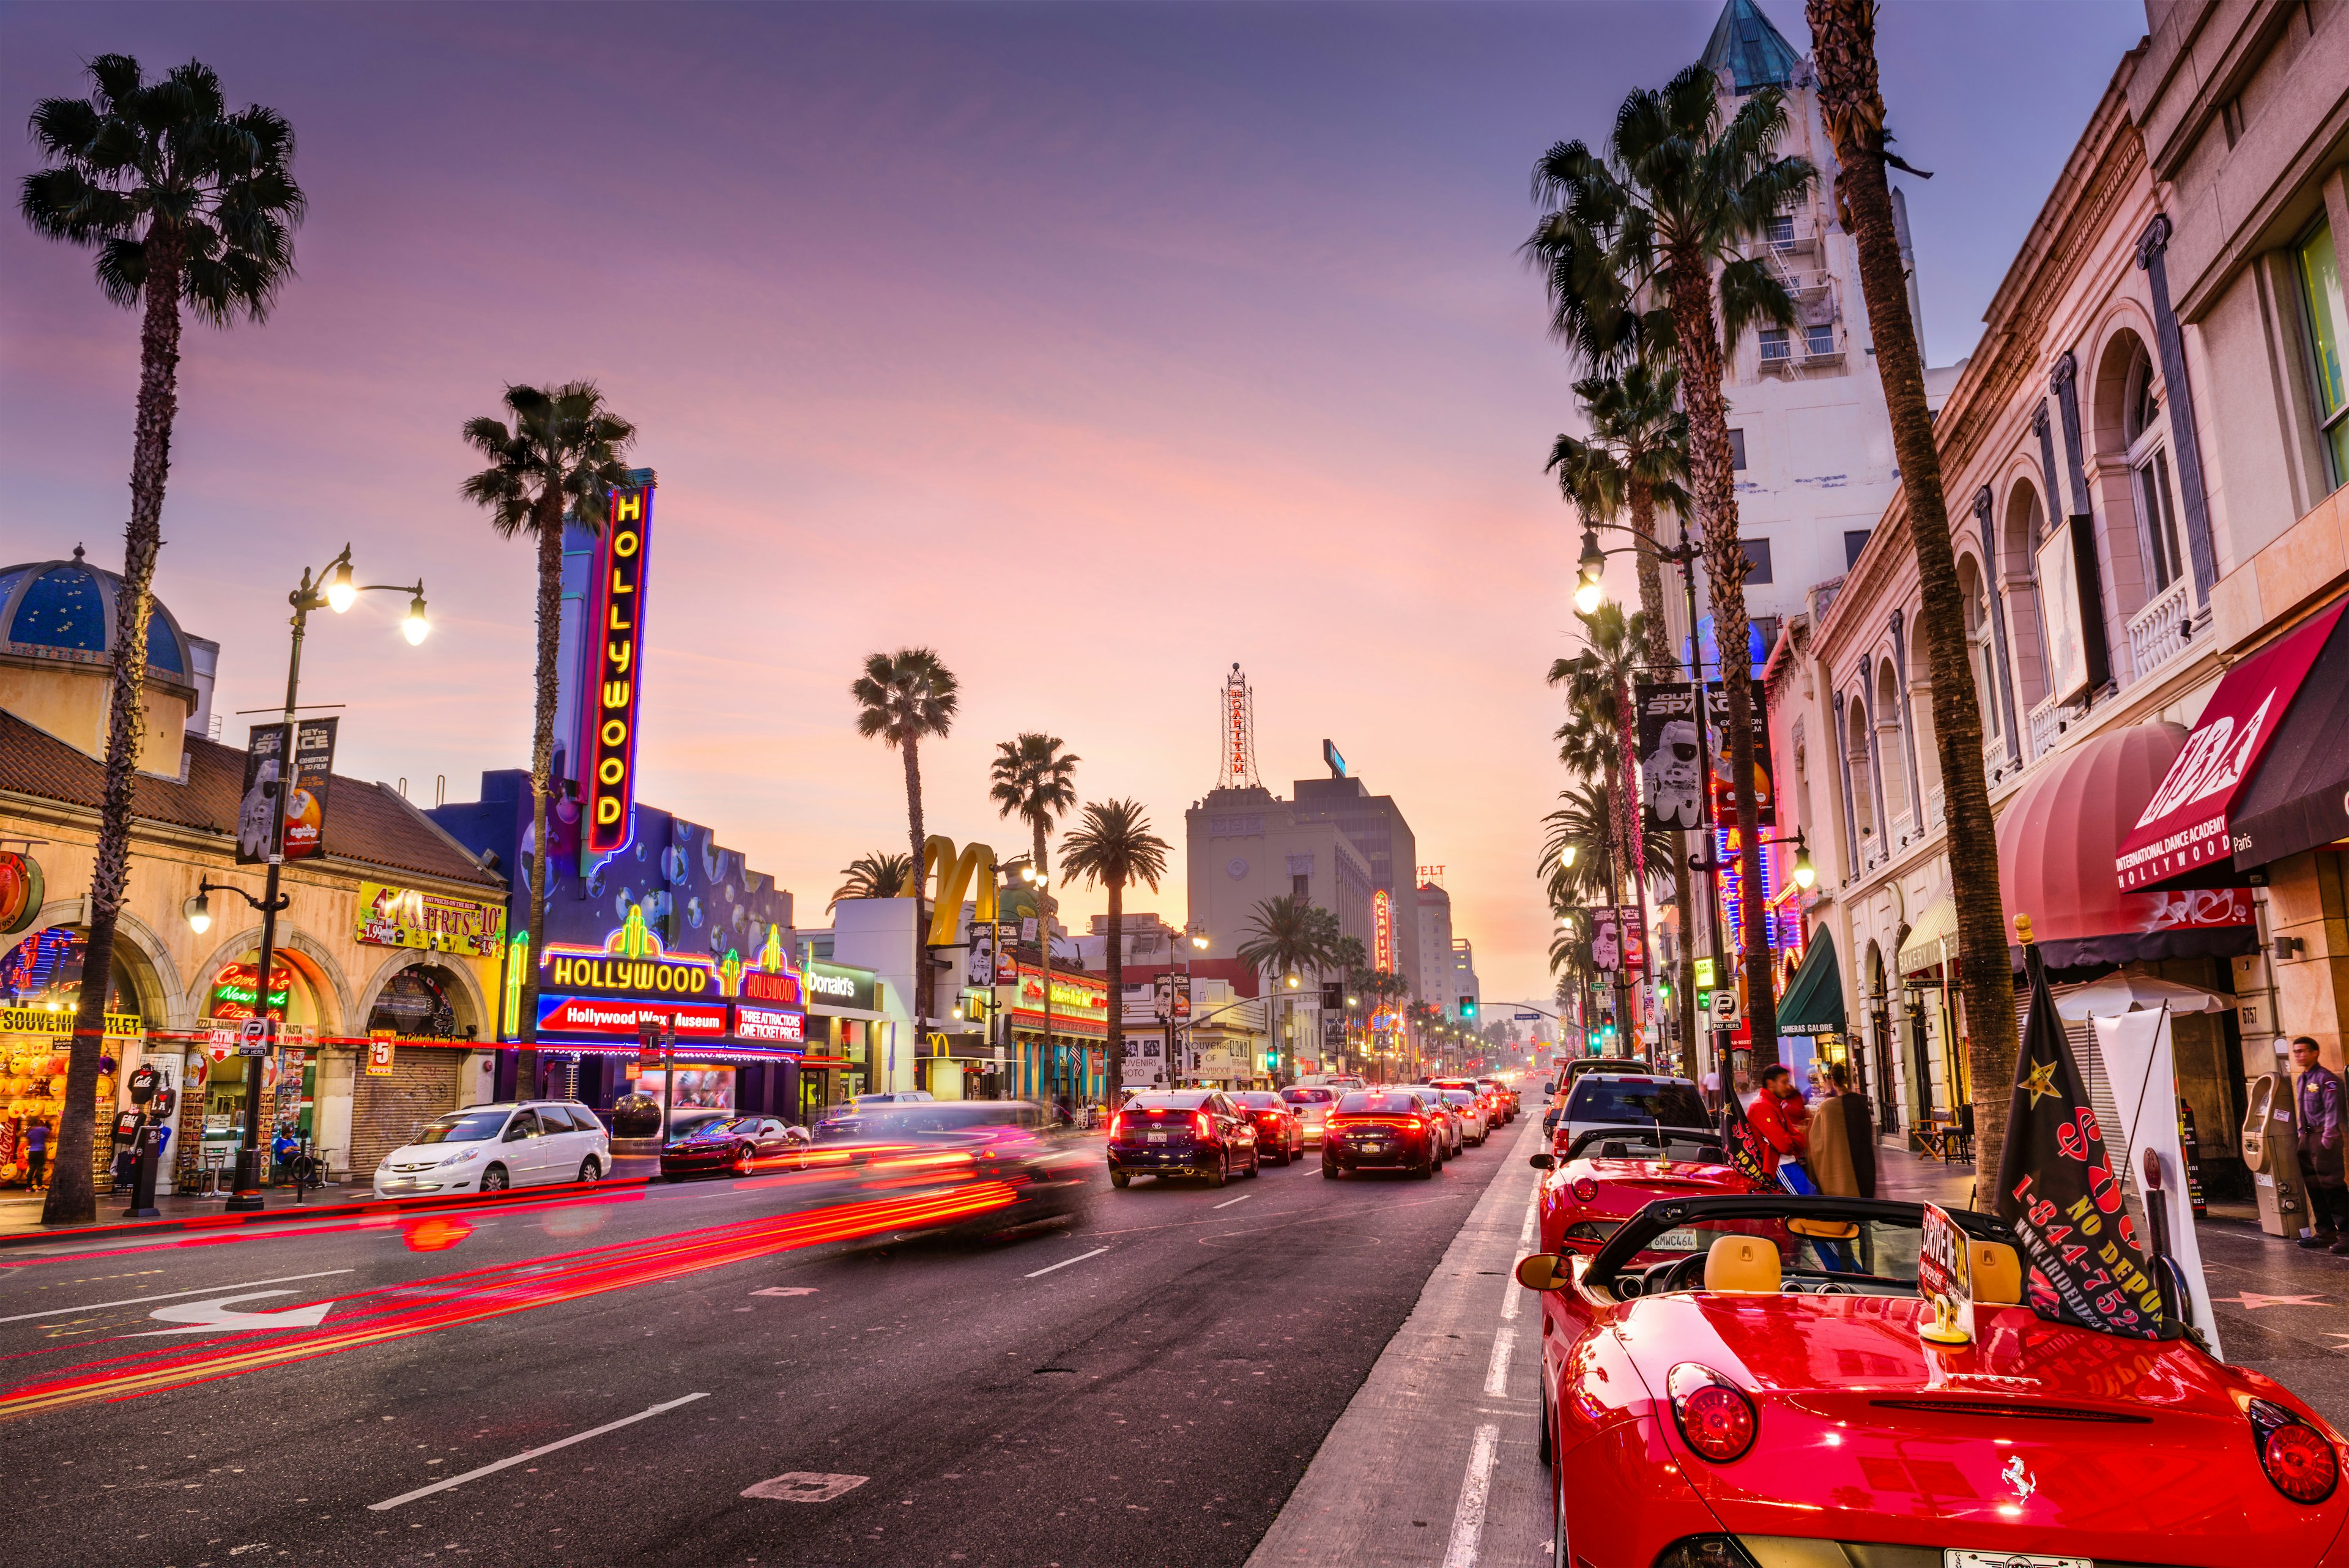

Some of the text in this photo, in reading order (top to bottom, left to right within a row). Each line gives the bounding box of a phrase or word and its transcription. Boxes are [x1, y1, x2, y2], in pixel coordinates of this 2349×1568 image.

[597, 493, 640, 825] HOLLYWOOD
[1649, 691, 1729, 700] JOURNE
[299, 756, 328, 764] EXHIBITION
[2115, 815, 2225, 872] INTERNATIONAL DANCE ACADEMY
[2233, 833, 2252, 853] Paris
[393, 905, 470, 937] T-SHIRTS
[1378, 907, 1387, 968] CAPITA
[1899, 946, 1927, 973] BAKERY
[215, 965, 290, 989] Como's
[555, 957, 705, 993] HOLLYWOOD
[748, 975, 795, 1001] HOLLYWOOD
[1050, 984, 1070, 1003] Believe
[3, 1011, 74, 1033] SOUVENI
[215, 1003, 280, 1021] Pizzeia
[567, 1007, 636, 1027] Hollywood
[638, 1010, 666, 1026] Wax
[740, 1010, 800, 1027] THREE ATTRACTIONS
[2242, 1006, 2257, 1025] 6757
[213, 1030, 231, 1044] ATM
[285, 1024, 302, 1035] PASTA
[740, 1022, 800, 1040] ONE TICKET PRICE!
[1781, 1023, 1833, 1033] CAMERAS GALORE
[406, 1033, 434, 1044] Celebrity
[434, 1034, 451, 1044] Home
[371, 1042, 389, 1064] $5
[135, 1076, 151, 1087] Cali
[1736, 1150, 1750, 1165] NO
[2065, 1194, 2102, 1236] NO
[1655, 1236, 1693, 1247] 6MWC464
[1922, 1211, 1946, 1266] DRIVE
[1920, 1260, 1943, 1288] NO DEPOSIT
